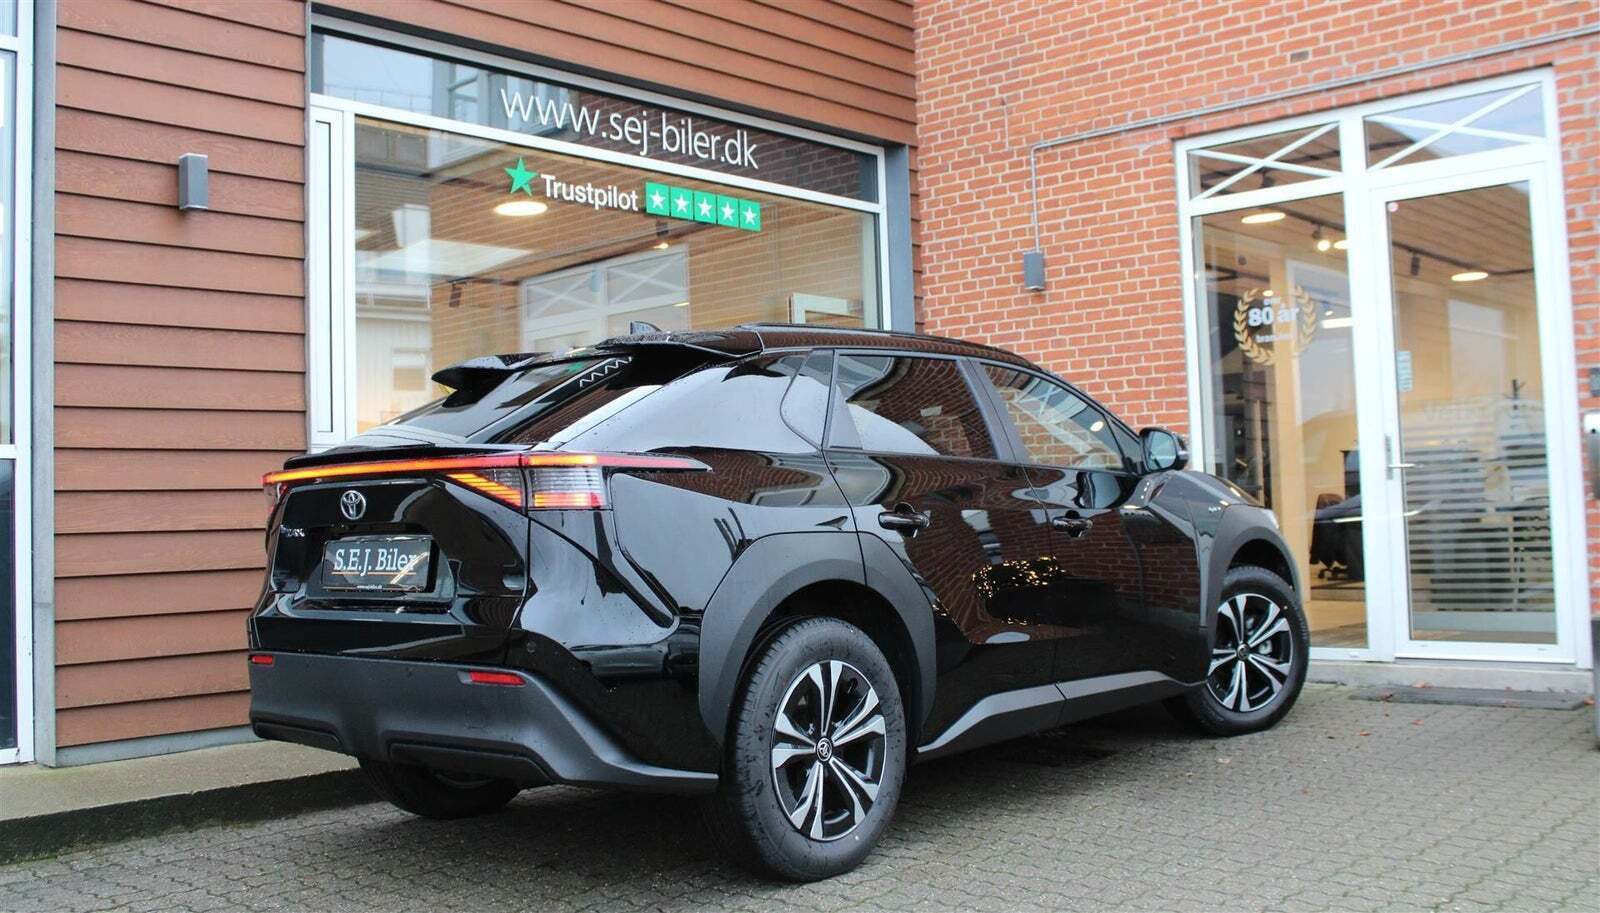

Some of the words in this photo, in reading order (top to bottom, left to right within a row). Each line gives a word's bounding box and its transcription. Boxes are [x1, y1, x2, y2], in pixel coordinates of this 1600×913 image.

[501, 89, 758, 168] www.sej-biler.dk
[541, 174, 638, 210] Trustpilot
[1248, 307, 1274, 326] 80
[334, 549, 371, 576] S.E.J.
[375, 549, 416, 571] Biler
